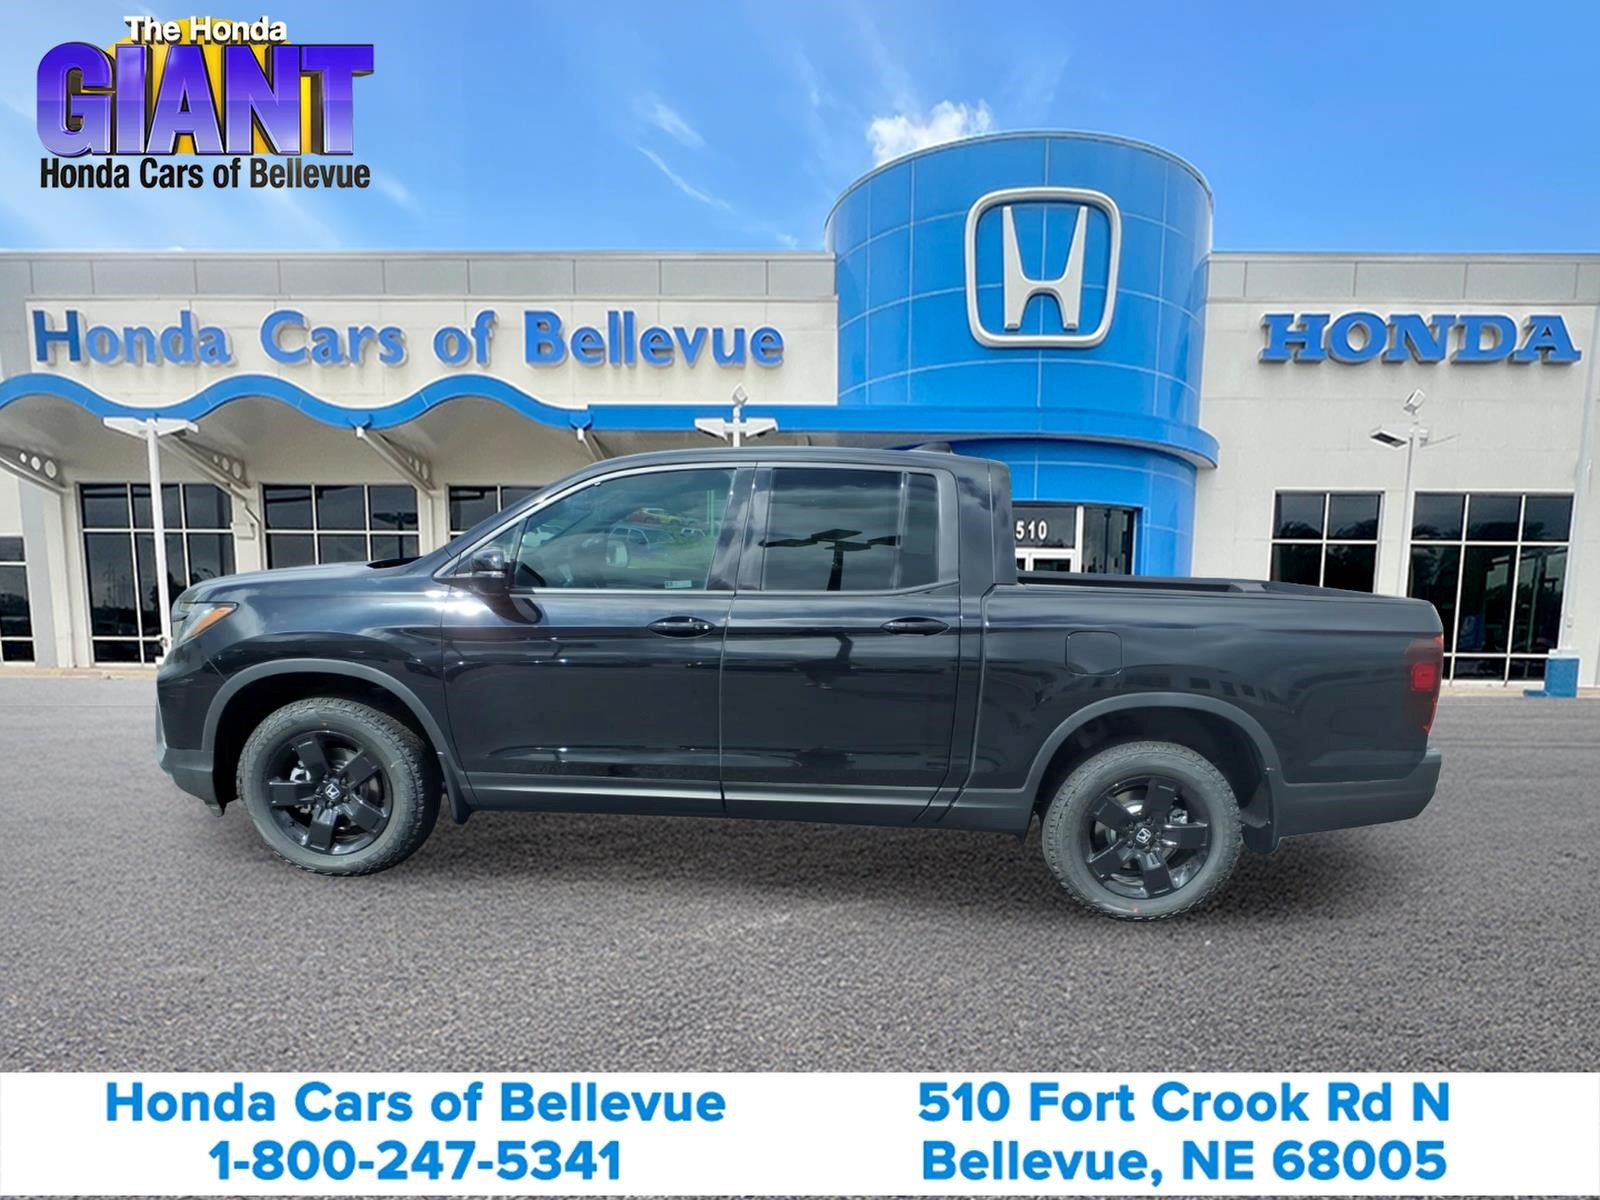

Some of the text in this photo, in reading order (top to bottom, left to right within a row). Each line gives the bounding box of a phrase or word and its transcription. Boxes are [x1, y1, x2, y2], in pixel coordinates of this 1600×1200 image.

[32, 309, 785, 367] Honda Cars of Bellevue
[1259, 311, 1582, 364] HONDA
[1015, 520, 1048, 540] 510
